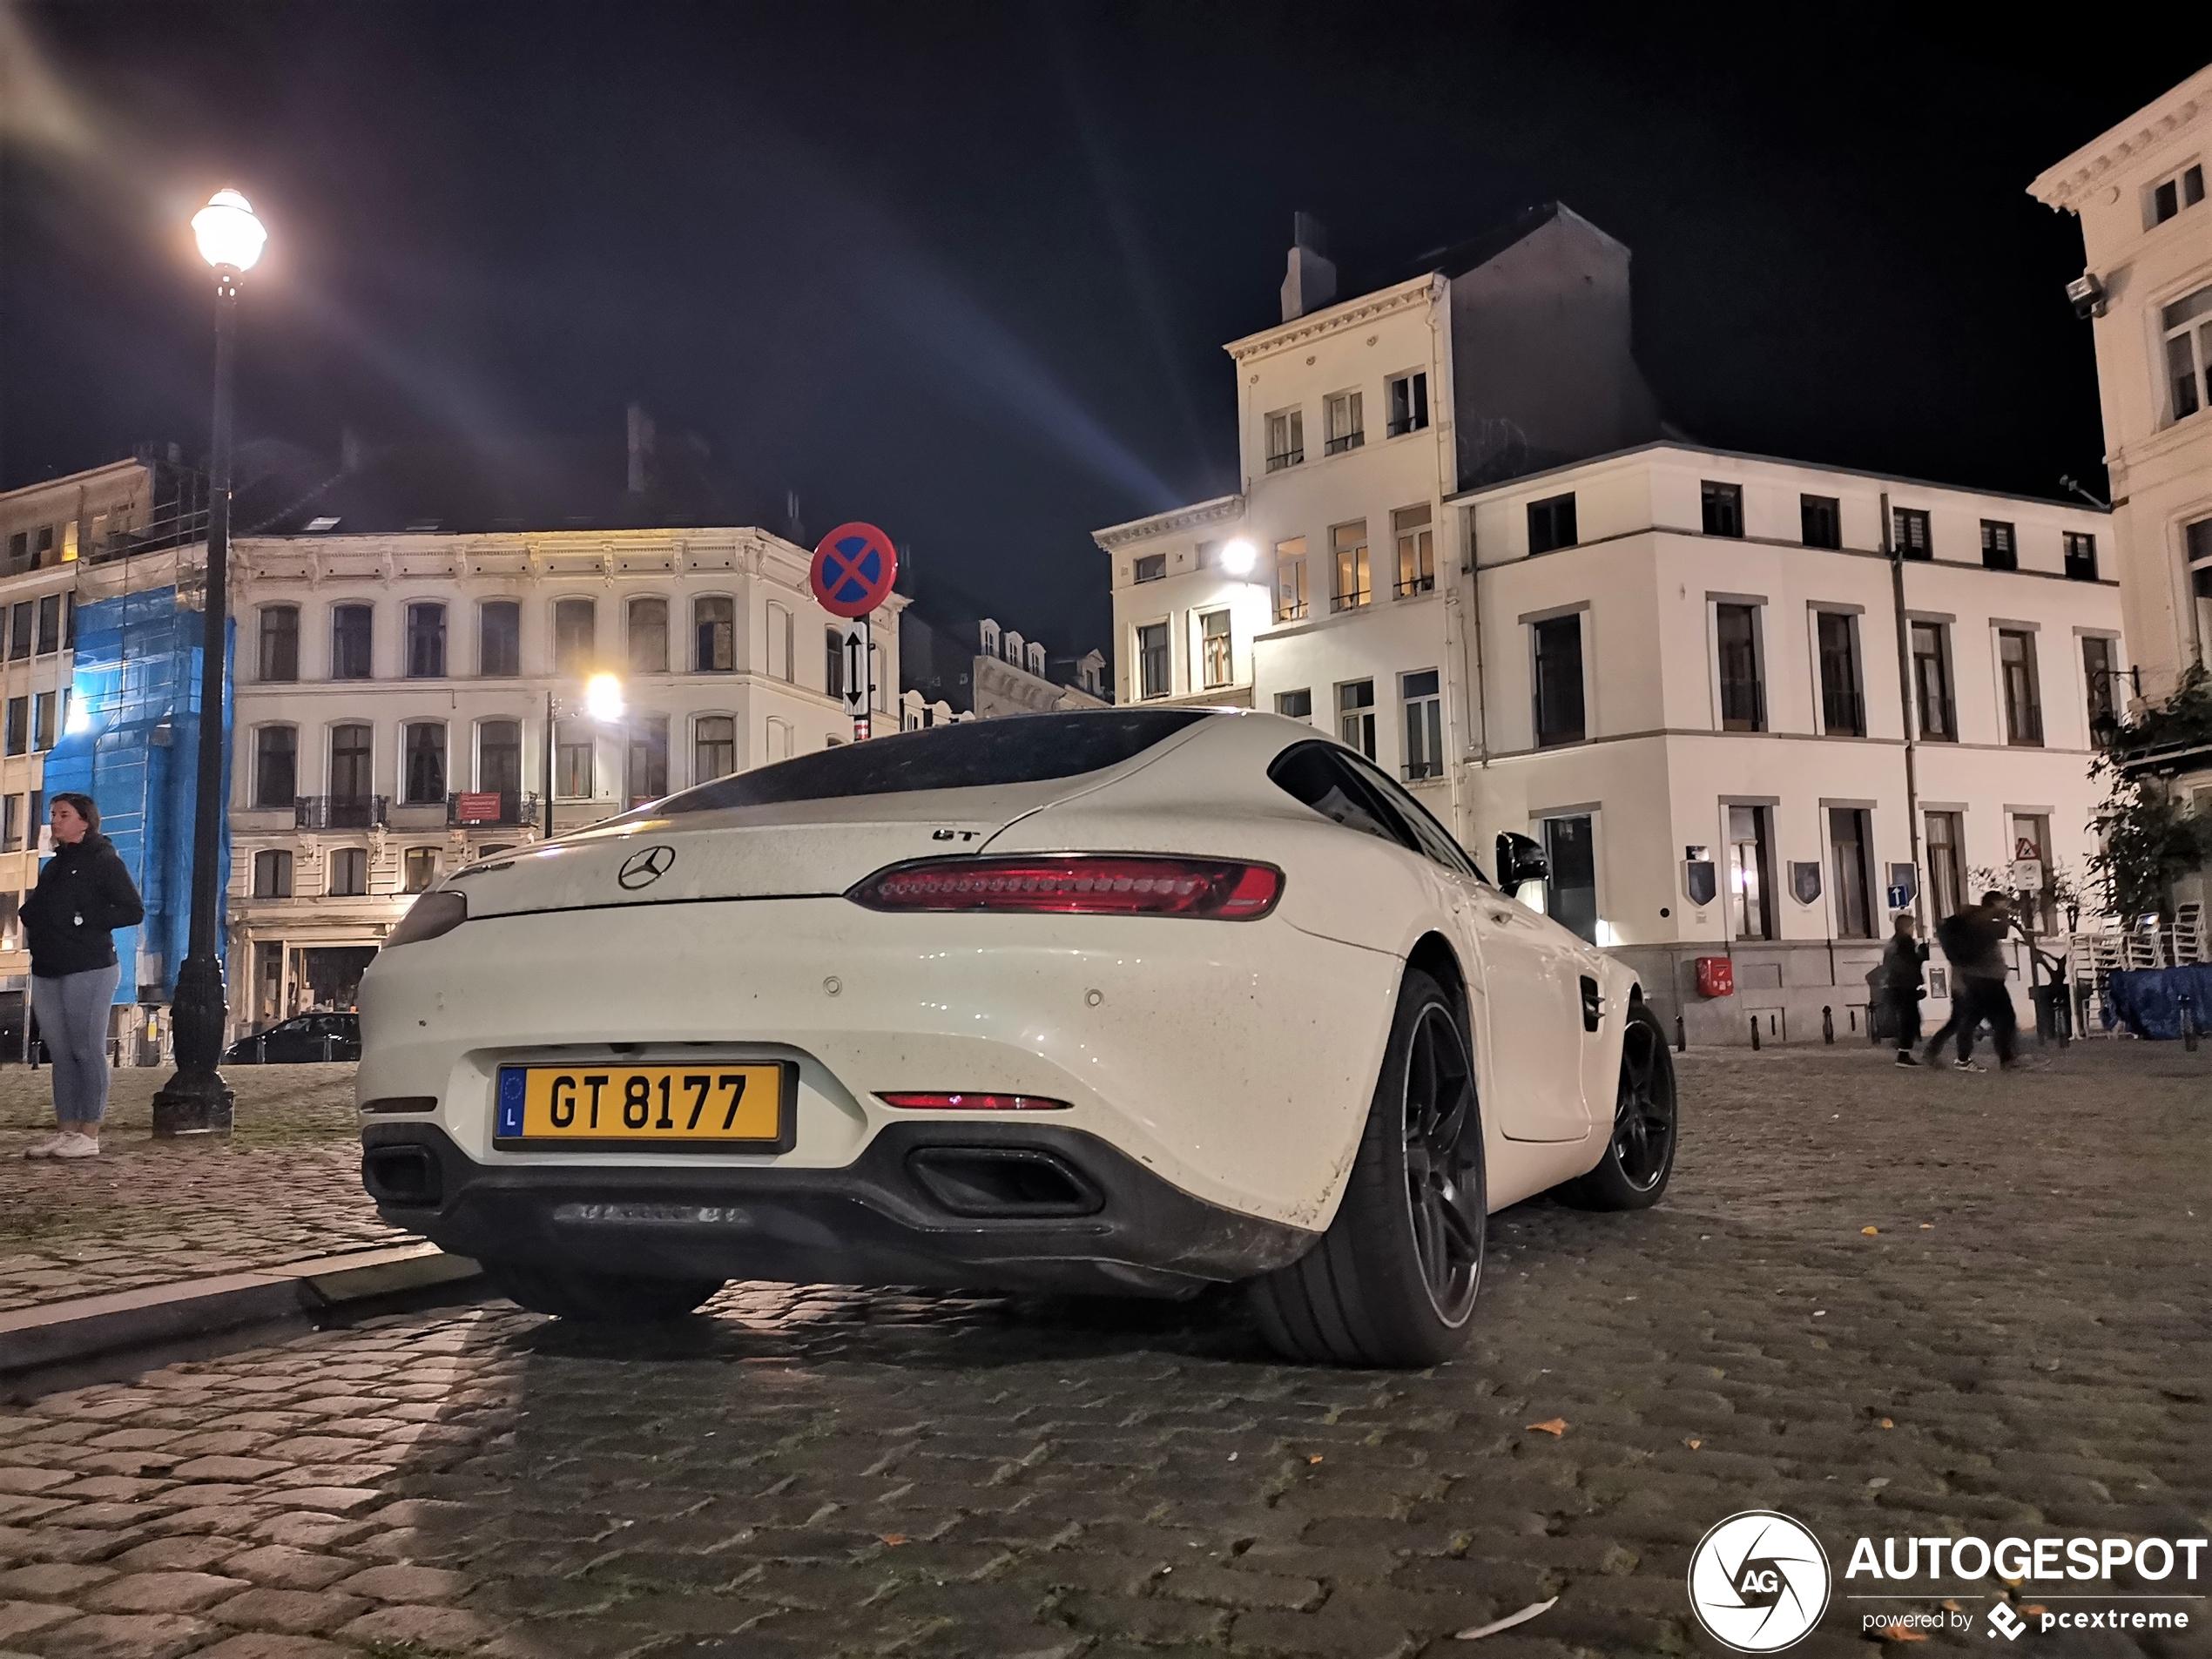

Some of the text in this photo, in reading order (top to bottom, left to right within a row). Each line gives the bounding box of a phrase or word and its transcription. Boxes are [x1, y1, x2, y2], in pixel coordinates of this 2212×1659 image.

[932, 829, 981, 841] GT
[550, 1075, 746, 1130] GT 8177
[507, 1109, 516, 1126] L
